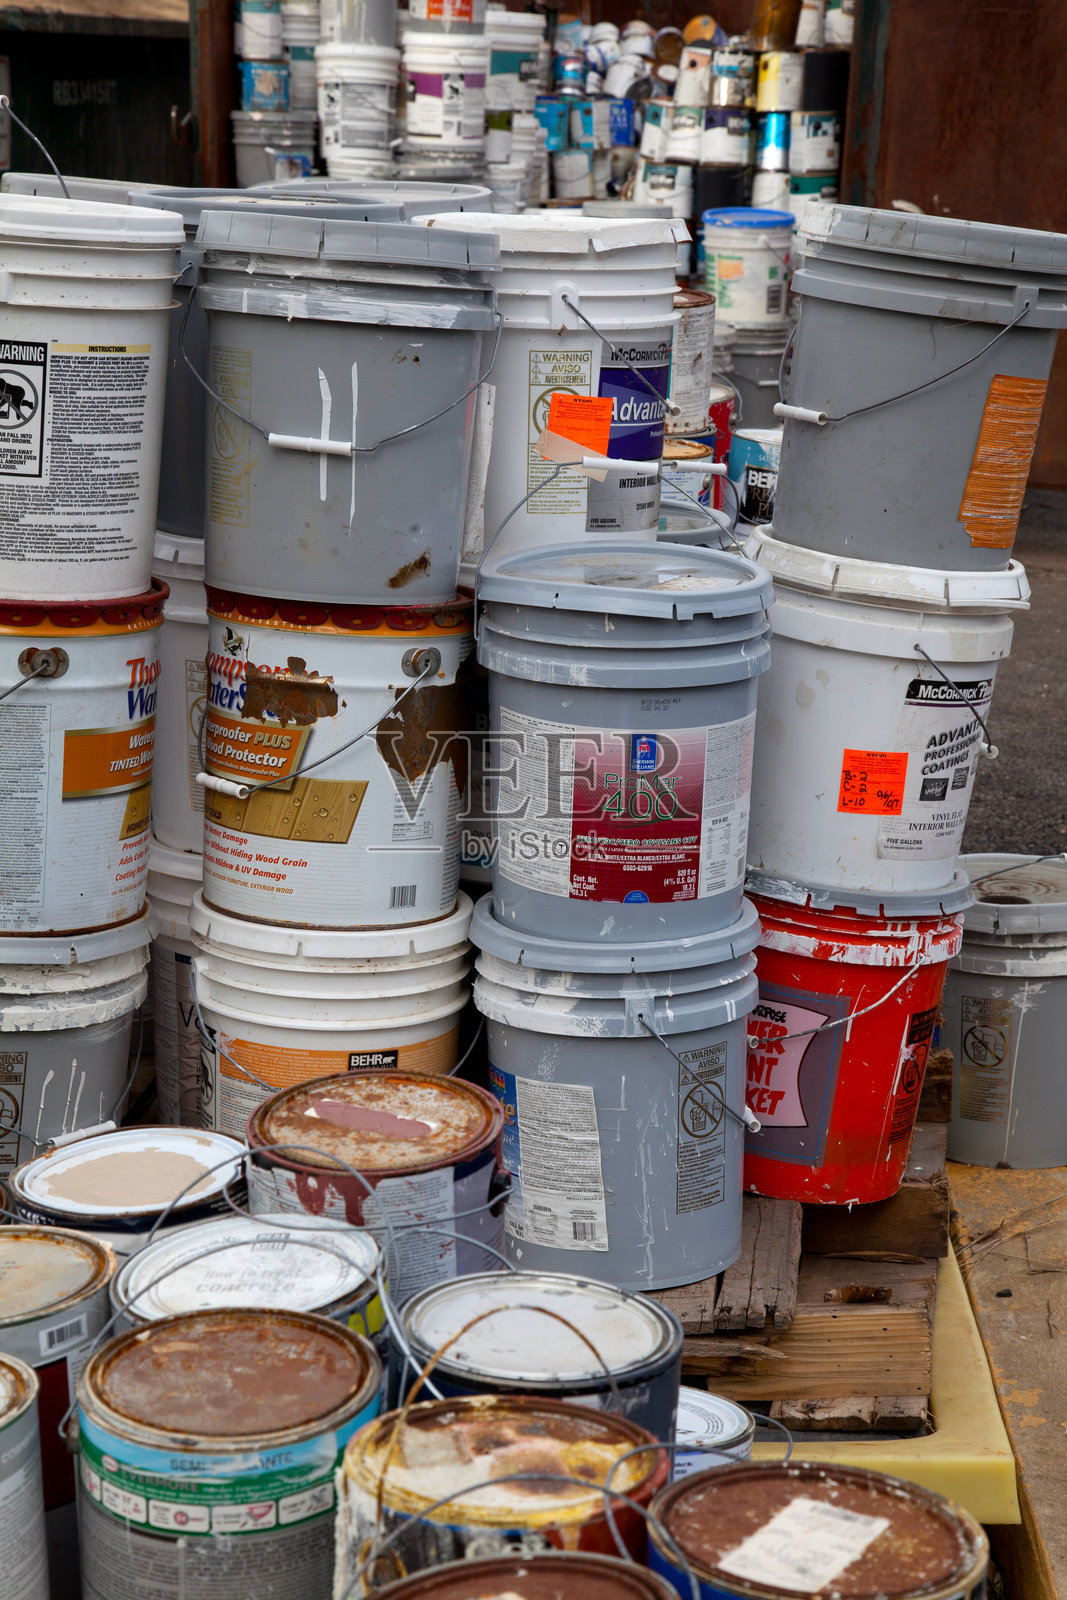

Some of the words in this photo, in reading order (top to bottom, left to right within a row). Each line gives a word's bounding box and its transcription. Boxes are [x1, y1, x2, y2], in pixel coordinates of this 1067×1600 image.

[542, 353, 589, 362] WARNING
[551, 364, 581, 373] AVISO
[545, 375, 586, 383] AVERTISSEMENT
[619, 477, 646, 488] INTERIOR
[254, 732, 292, 749] PLUS
[225, 744, 287, 768] Protector
[110, 756, 139, 773] TINTED
[921, 749, 970, 776] COATINGS
[604, 773, 680, 790] ProMar
[603, 790, 678, 820] 400
[931, 813, 950, 821] VINYL
[909, 822, 944, 831] INTERIOR
[222, 832, 248, 845] Damage
[577, 834, 597, 844] ZERO
[599, 837, 640, 846] VOC/CERO
[642, 837, 681, 846] COV/SANS
[682, 835, 698, 843] COV
[211, 841, 229, 854] Without
[230, 848, 253, 862] Hiding
[255, 853, 280, 865] Wood
[282, 857, 308, 868] Grain
[637, 853, 671, 861] BLANCO/EXTRA
[119, 856, 133, 866] Adds
[215, 857, 234, 870] Mildew
[235, 864, 240, 872] &
[241, 865, 251, 874] UV
[253, 868, 287, 882] Damage
[115, 870, 136, 882] Coating
[676, 876, 687, 884] U.S.
[226, 876, 250, 888] FURNITURE,
[250, 883, 274, 892] EXTERIOR
[691, 1044, 725, 1060] WARNING
[351, 1054, 383, 1066] BEHR
[698, 1057, 720, 1069] AVISO
[195, 1281, 296, 1293] concrete
[121, 1469, 199, 1493] EVERMORE
